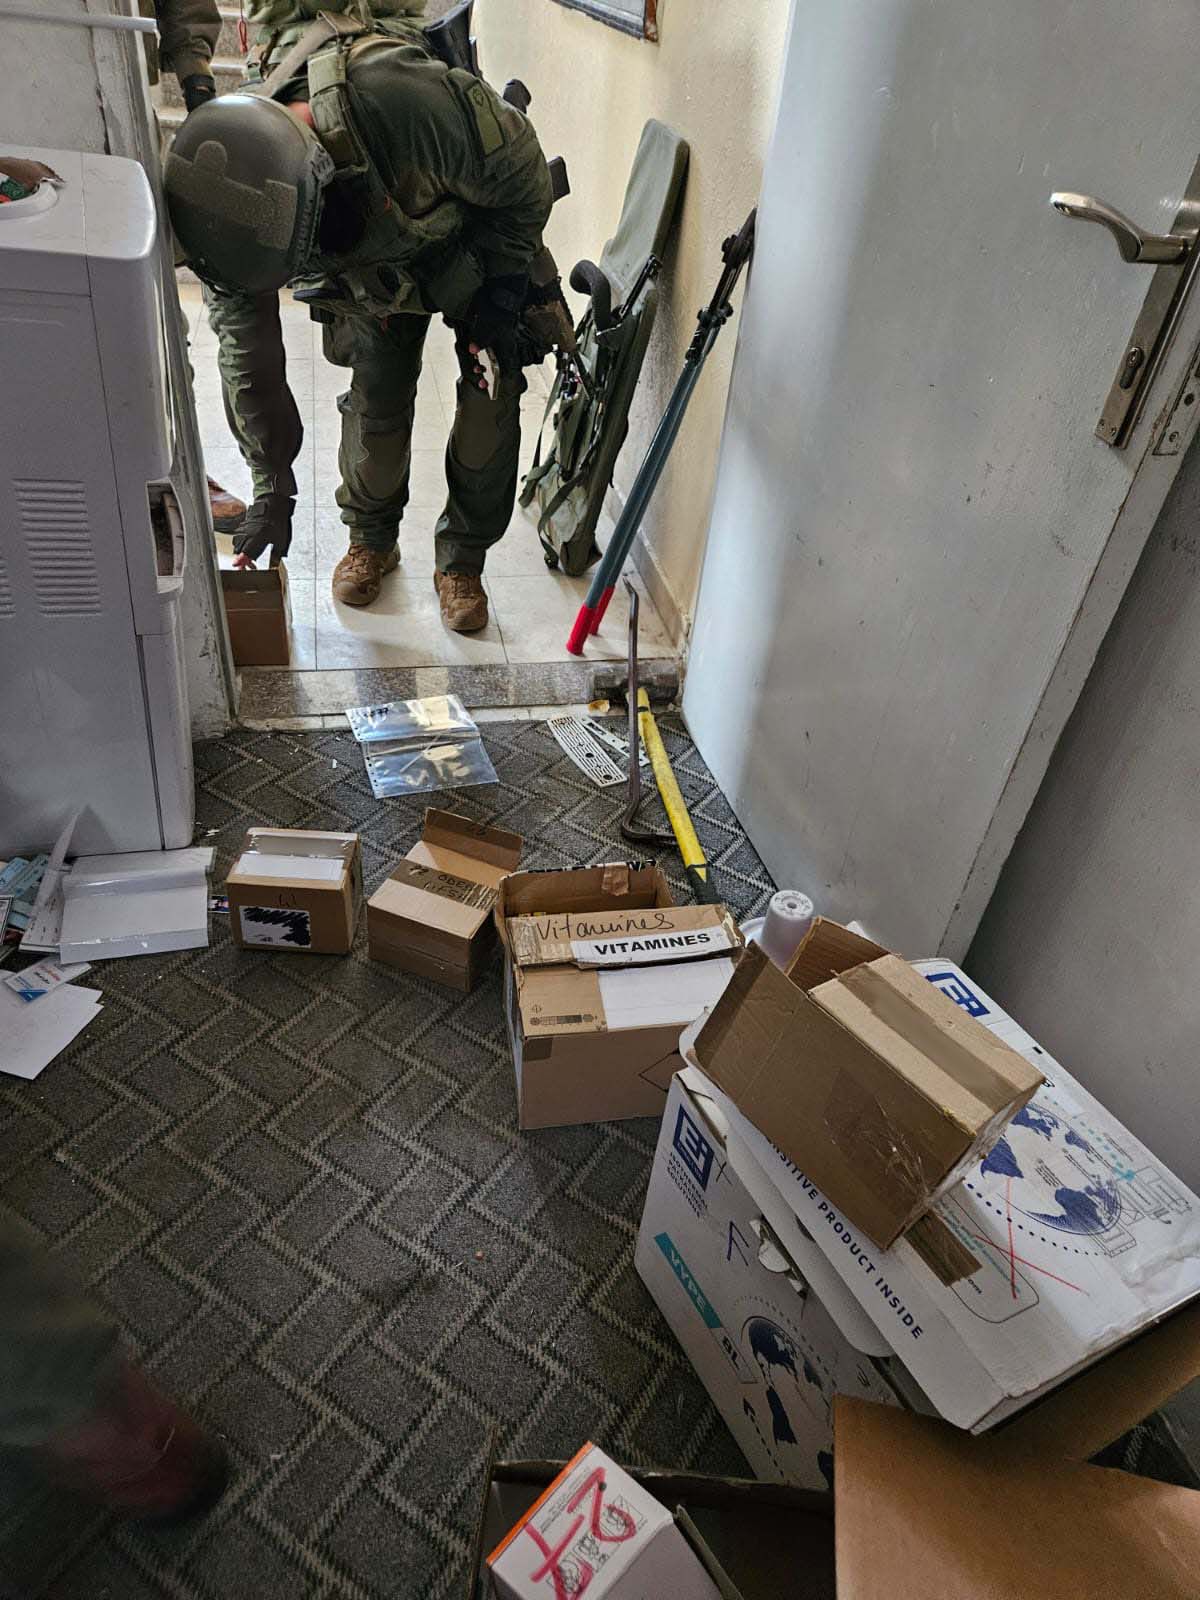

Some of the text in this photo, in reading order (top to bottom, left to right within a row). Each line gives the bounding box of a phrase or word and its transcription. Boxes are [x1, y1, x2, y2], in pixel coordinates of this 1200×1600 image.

[536, 913, 675, 941] Vitamines
[594, 932, 711, 955] VITAMINES
[773, 1144, 924, 1339] SITIVE PRODUCT INSIDE
